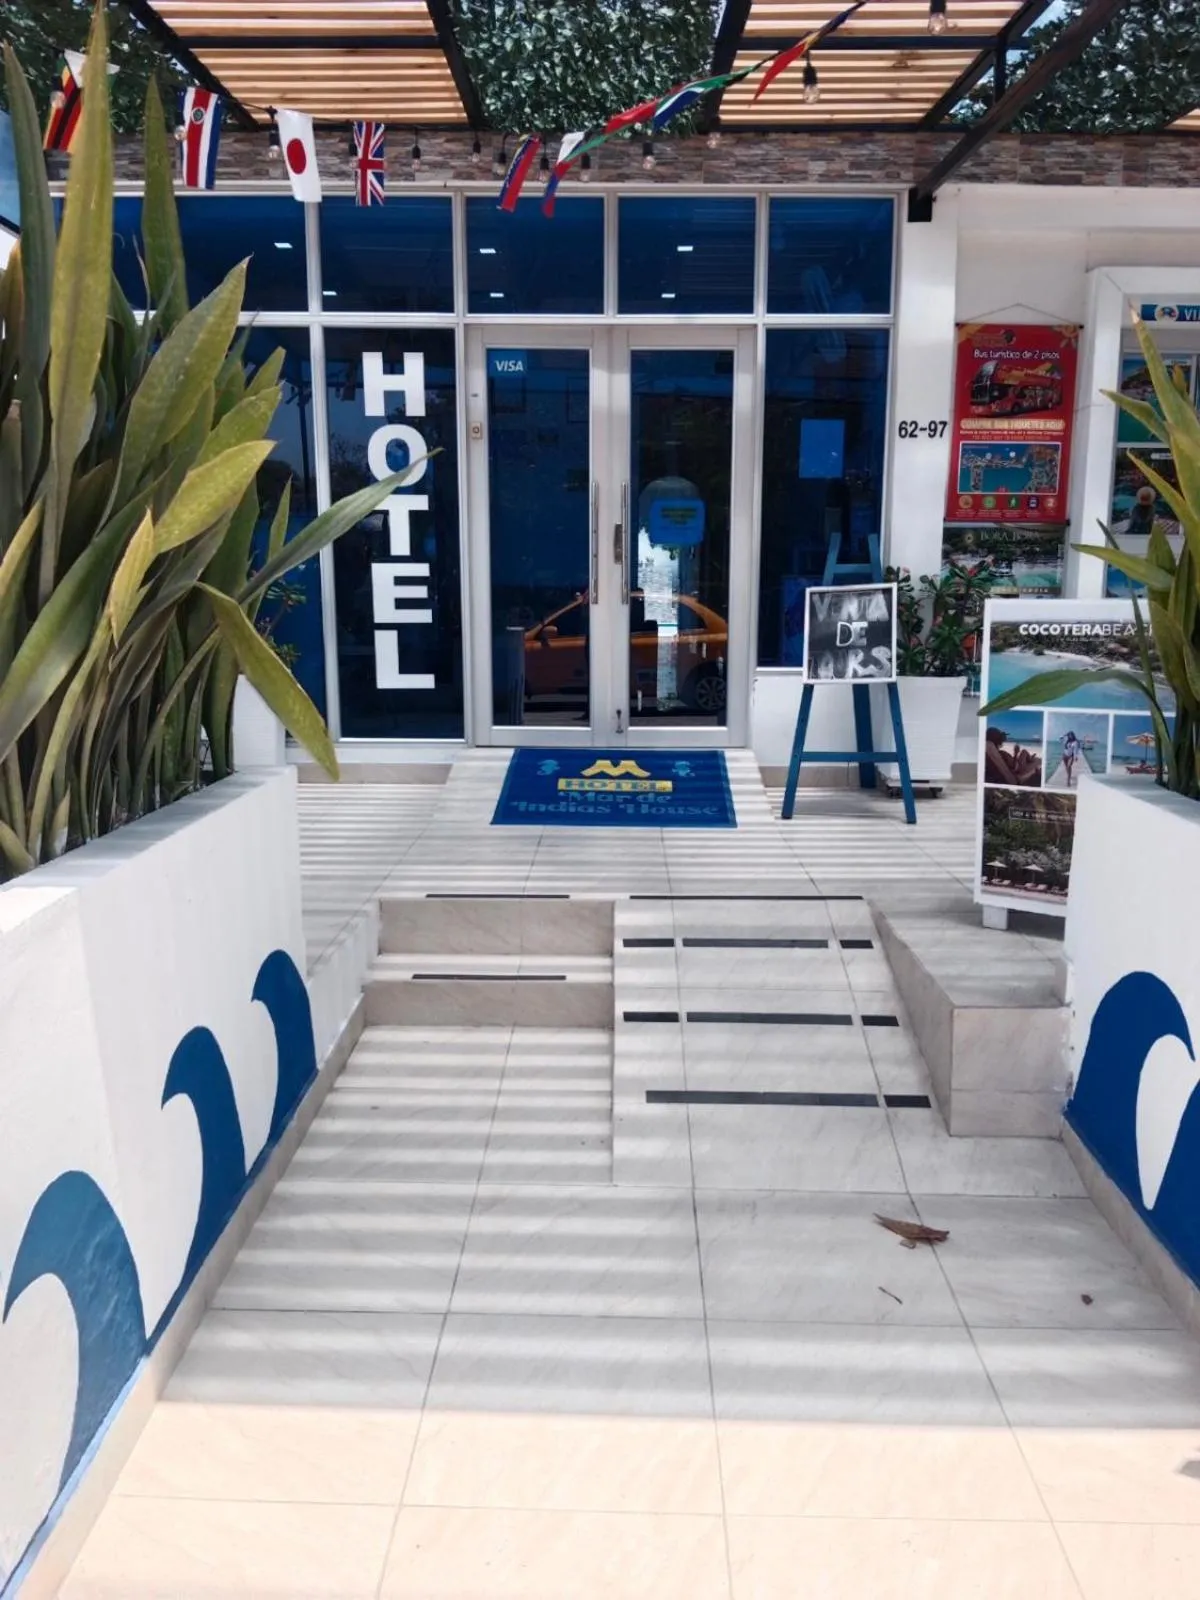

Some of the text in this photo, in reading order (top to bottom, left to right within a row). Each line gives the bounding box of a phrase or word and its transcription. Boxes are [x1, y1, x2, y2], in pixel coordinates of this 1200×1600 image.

[974, 348, 989, 359] Bus
[1022, 350, 1032, 359] de
[1034, 350, 1040, 360] 2
[1041, 351, 1060, 361] pisos
[495, 360, 524, 372] VISA
[898, 420, 948, 438] 62-97
[362, 352, 435, 689] HOTEL
[836, 621, 868, 647] DE
[563, 780, 660, 791] HOTEL
